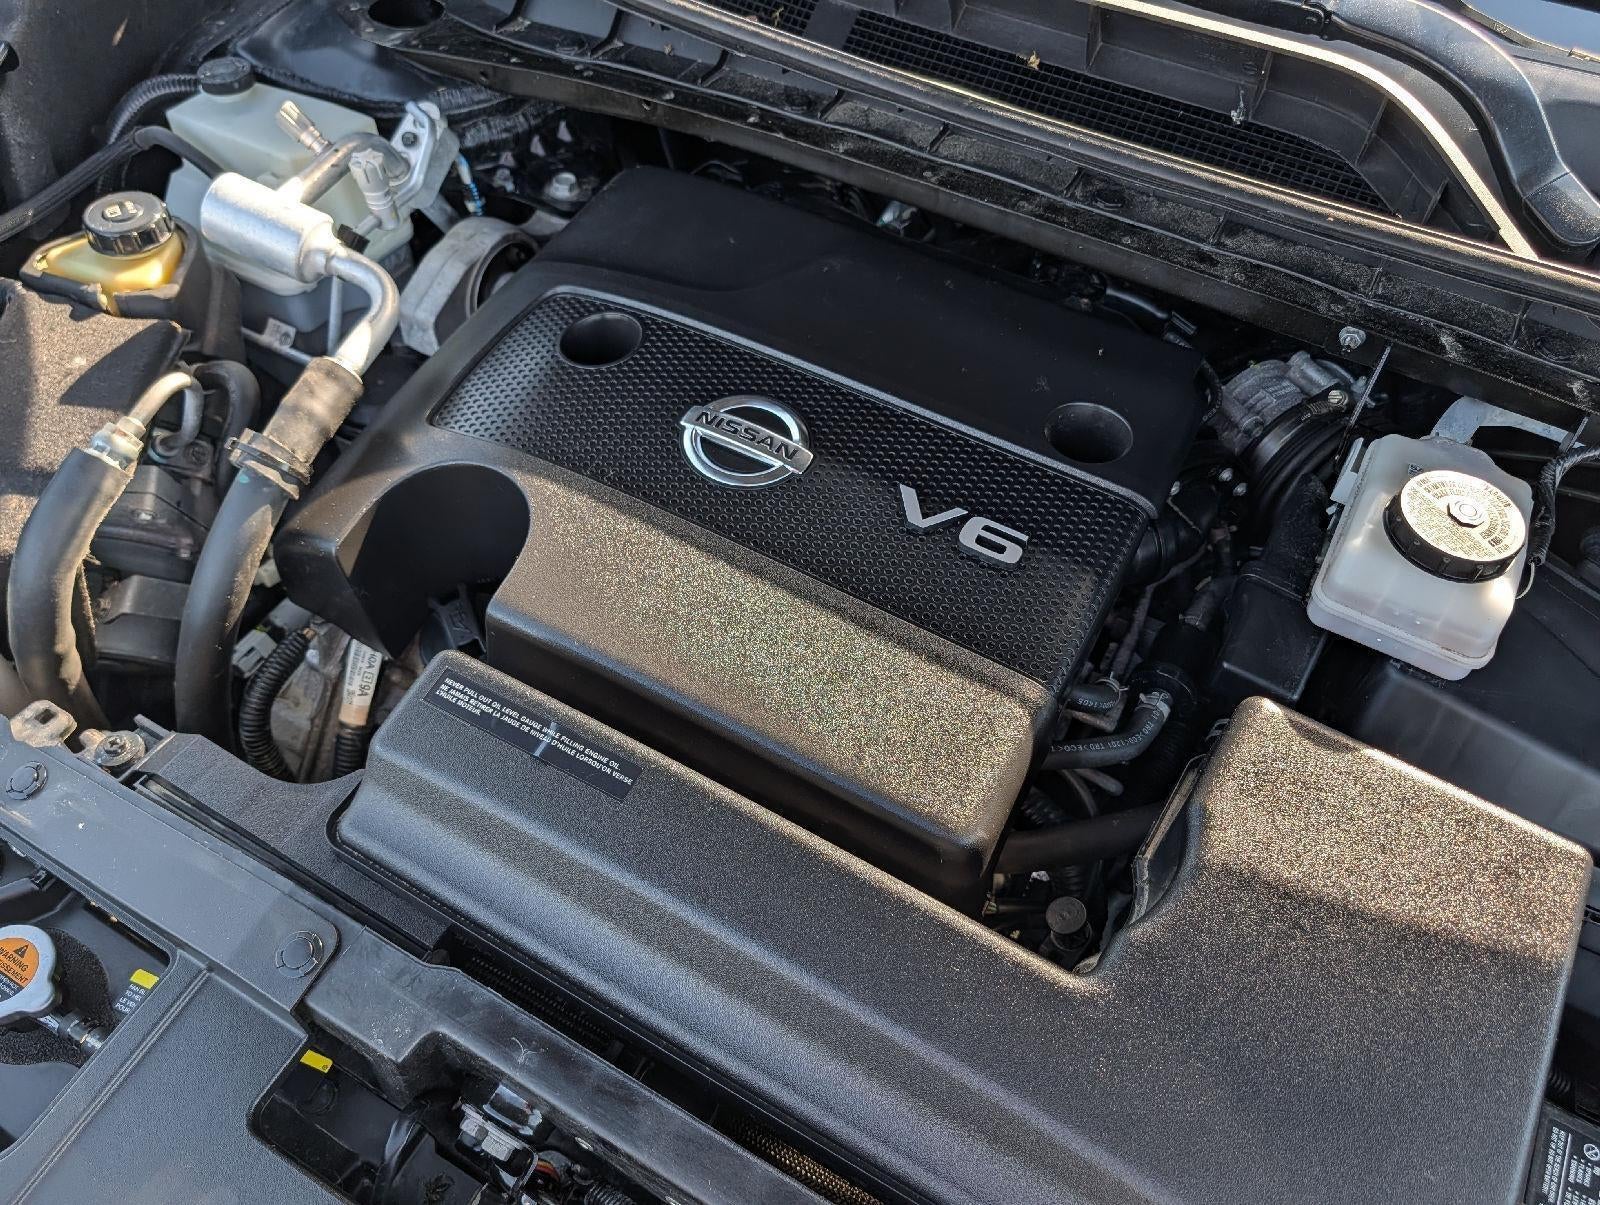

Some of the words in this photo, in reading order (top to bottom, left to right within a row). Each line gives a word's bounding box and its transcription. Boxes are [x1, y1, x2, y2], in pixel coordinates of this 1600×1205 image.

[696, 411, 800, 461] NISSAN
[899, 483, 1029, 565] V6
[445, 677, 464, 690] NEVER
[463, 687, 479, 698] PULL
[478, 694, 492, 704] OUT
[491, 701, 502, 710] OIL
[502, 706, 521, 719] LEVEL
[520, 715, 542, 730] GAUGE
[560, 736, 585, 751] FILLING
[584, 748, 609, 764] ENGINE
[449, 688, 470, 702] JAMAIS
[469, 698, 494, 714] RETIRER
[500, 714, 521, 728] JAUGE
[520, 724, 530, 732] DE
[611, 771, 634, 785] VERSE
[0, 946, 28, 972] WARNING
[0, 962, 28, 984] ISSEMENT
